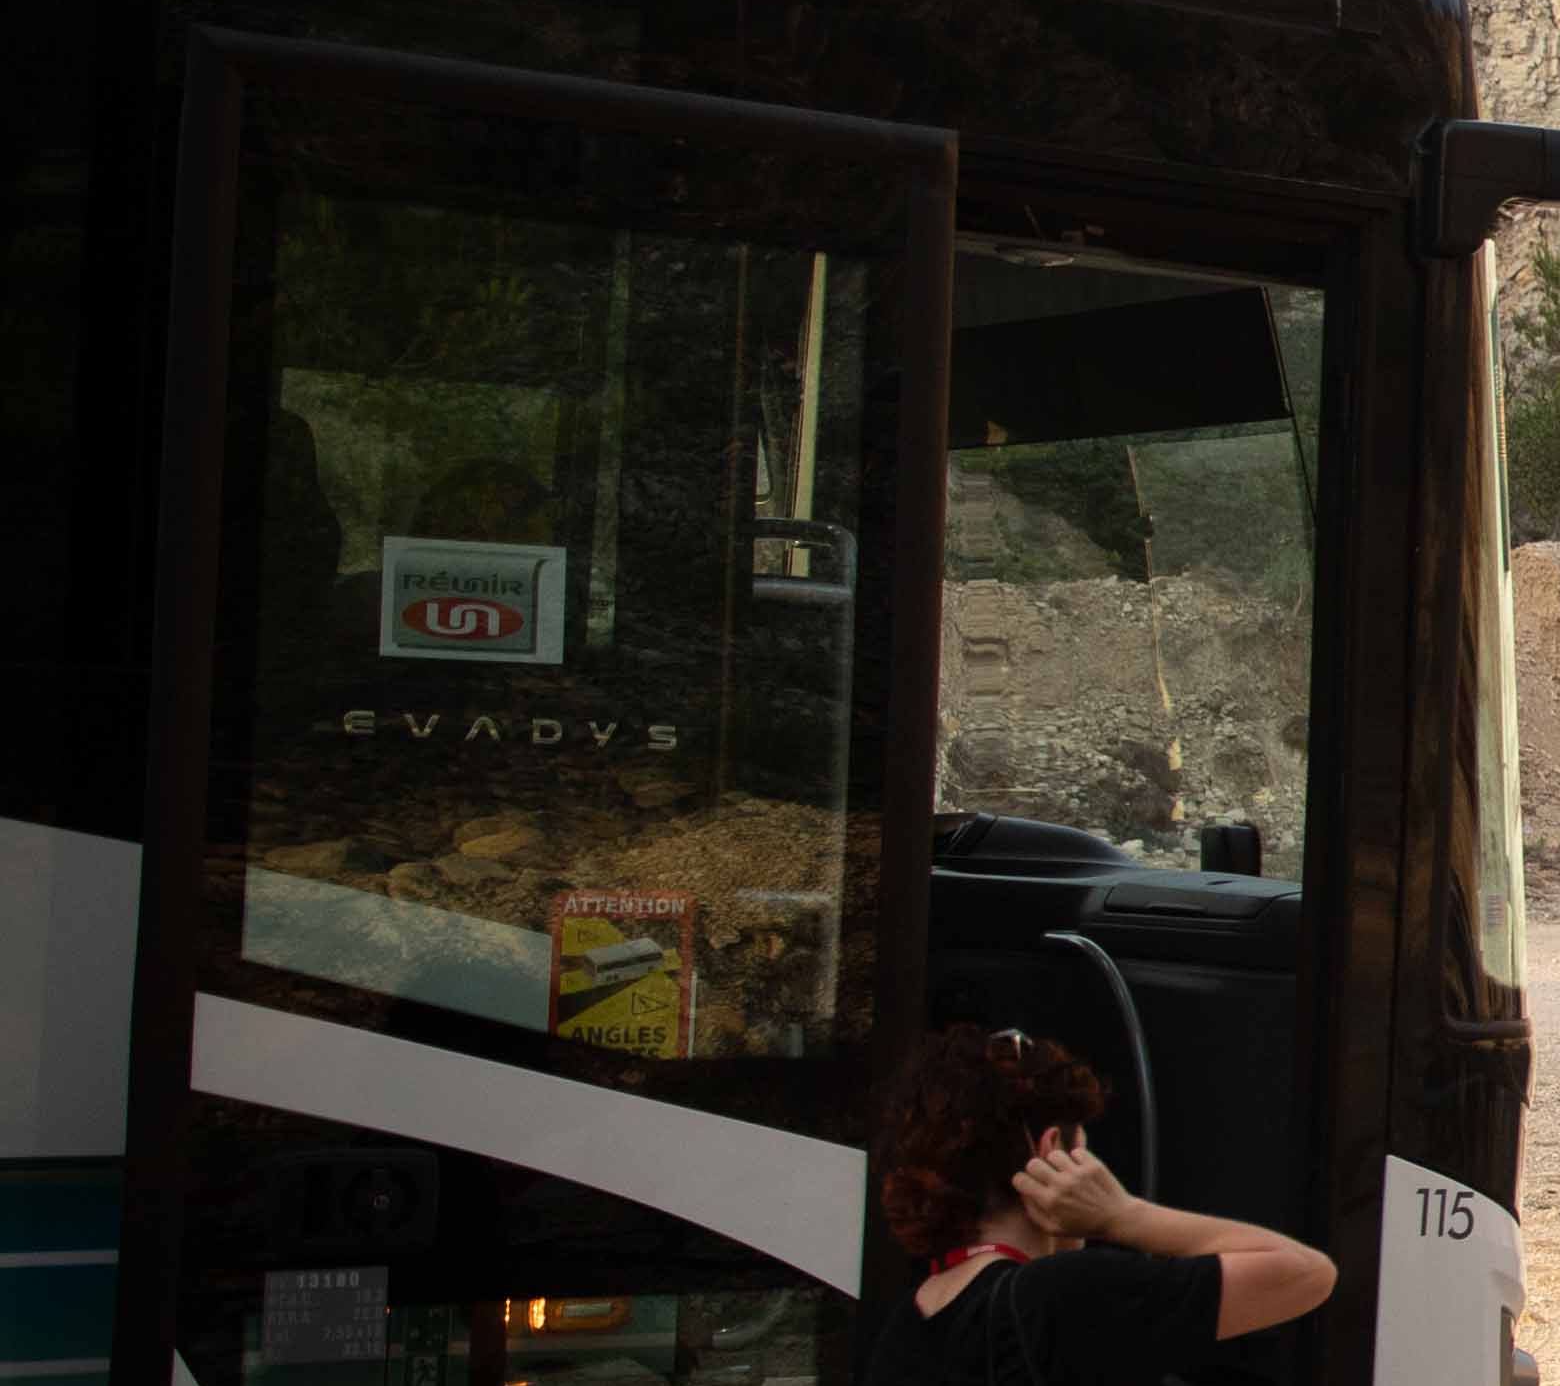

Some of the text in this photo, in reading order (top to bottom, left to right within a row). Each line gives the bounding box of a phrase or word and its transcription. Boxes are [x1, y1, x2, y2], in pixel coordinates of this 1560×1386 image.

[344, 710, 677, 749] EVADYS
[564, 895, 686, 913] ATTENTION
[572, 1027, 666, 1044] ANGLES
[1416, 1188, 1474, 1240] 115
